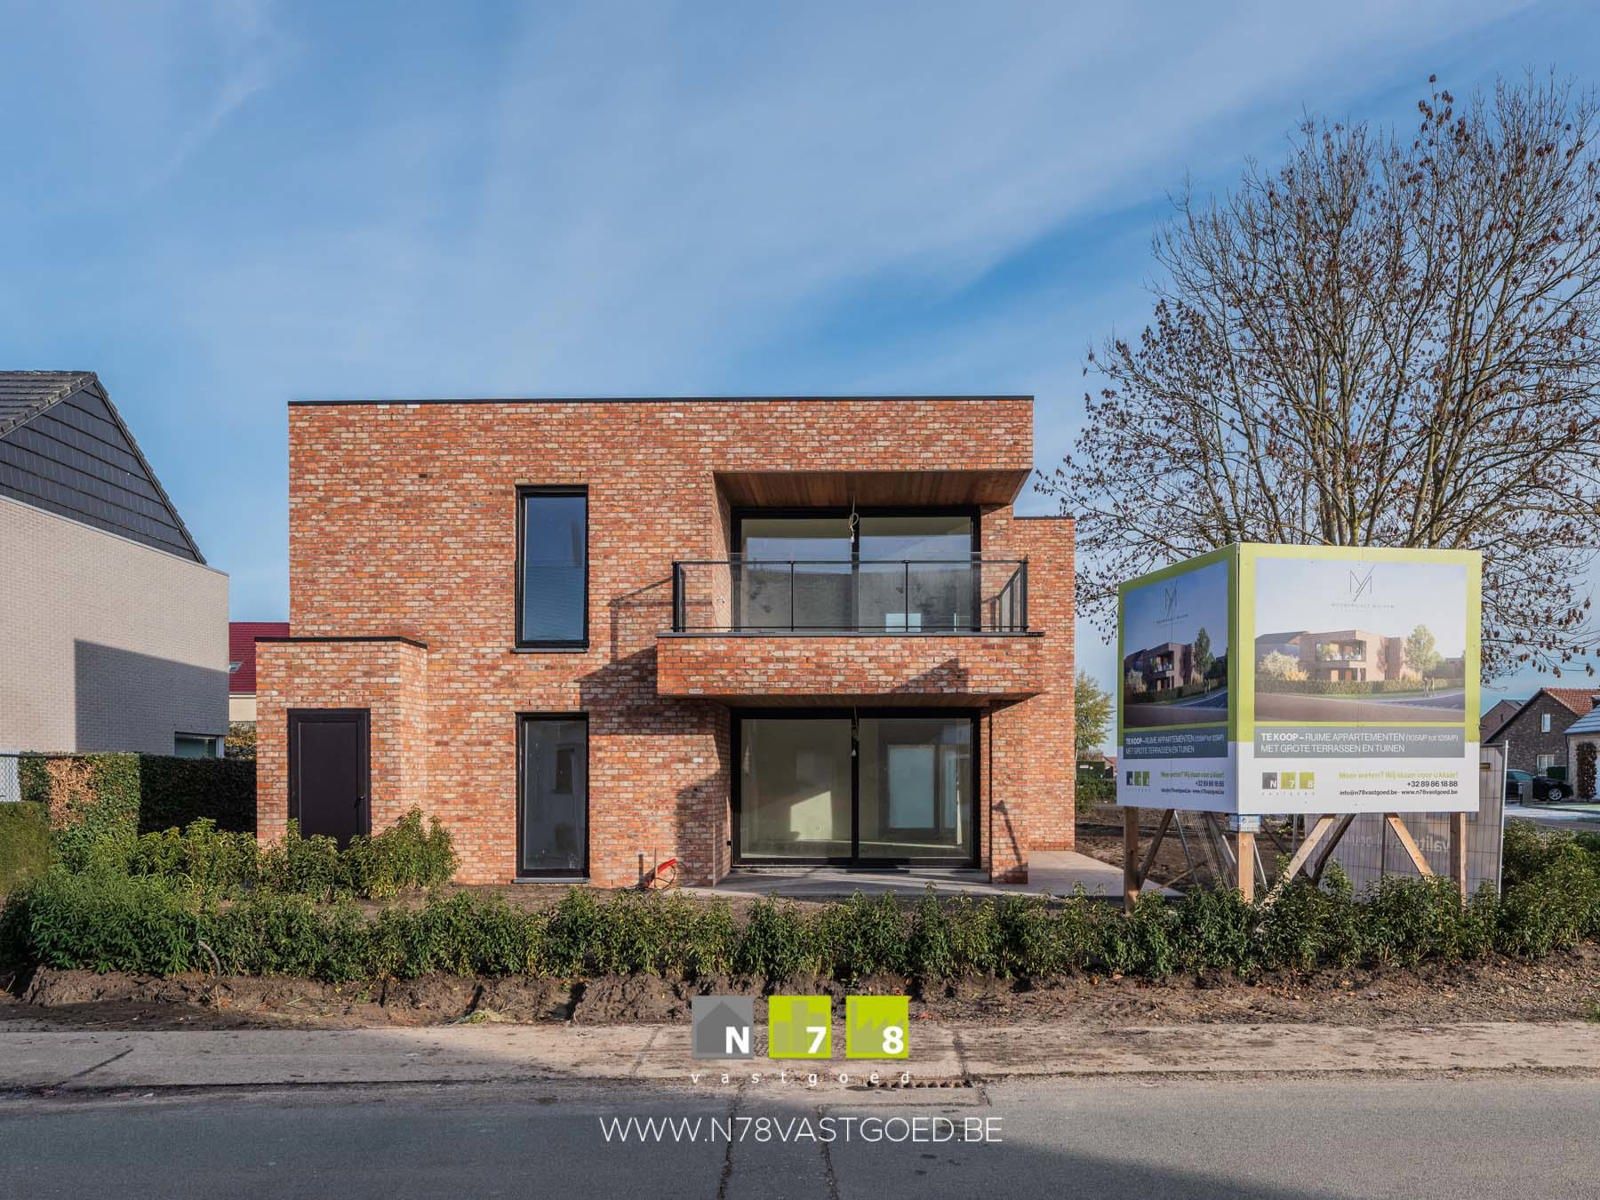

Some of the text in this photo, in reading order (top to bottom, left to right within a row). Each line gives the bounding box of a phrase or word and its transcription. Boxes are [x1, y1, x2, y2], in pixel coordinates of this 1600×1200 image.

[1262, 732, 1272, 741] TE
[1273, 732, 1298, 741] KOOP
[1305, 732, 1332, 741] RUIME
[1333, 732, 1405, 741] APPARTEMENTEN
[1260, 744, 1405, 753] MET GROTE TERRASSEN EN TUINEN
